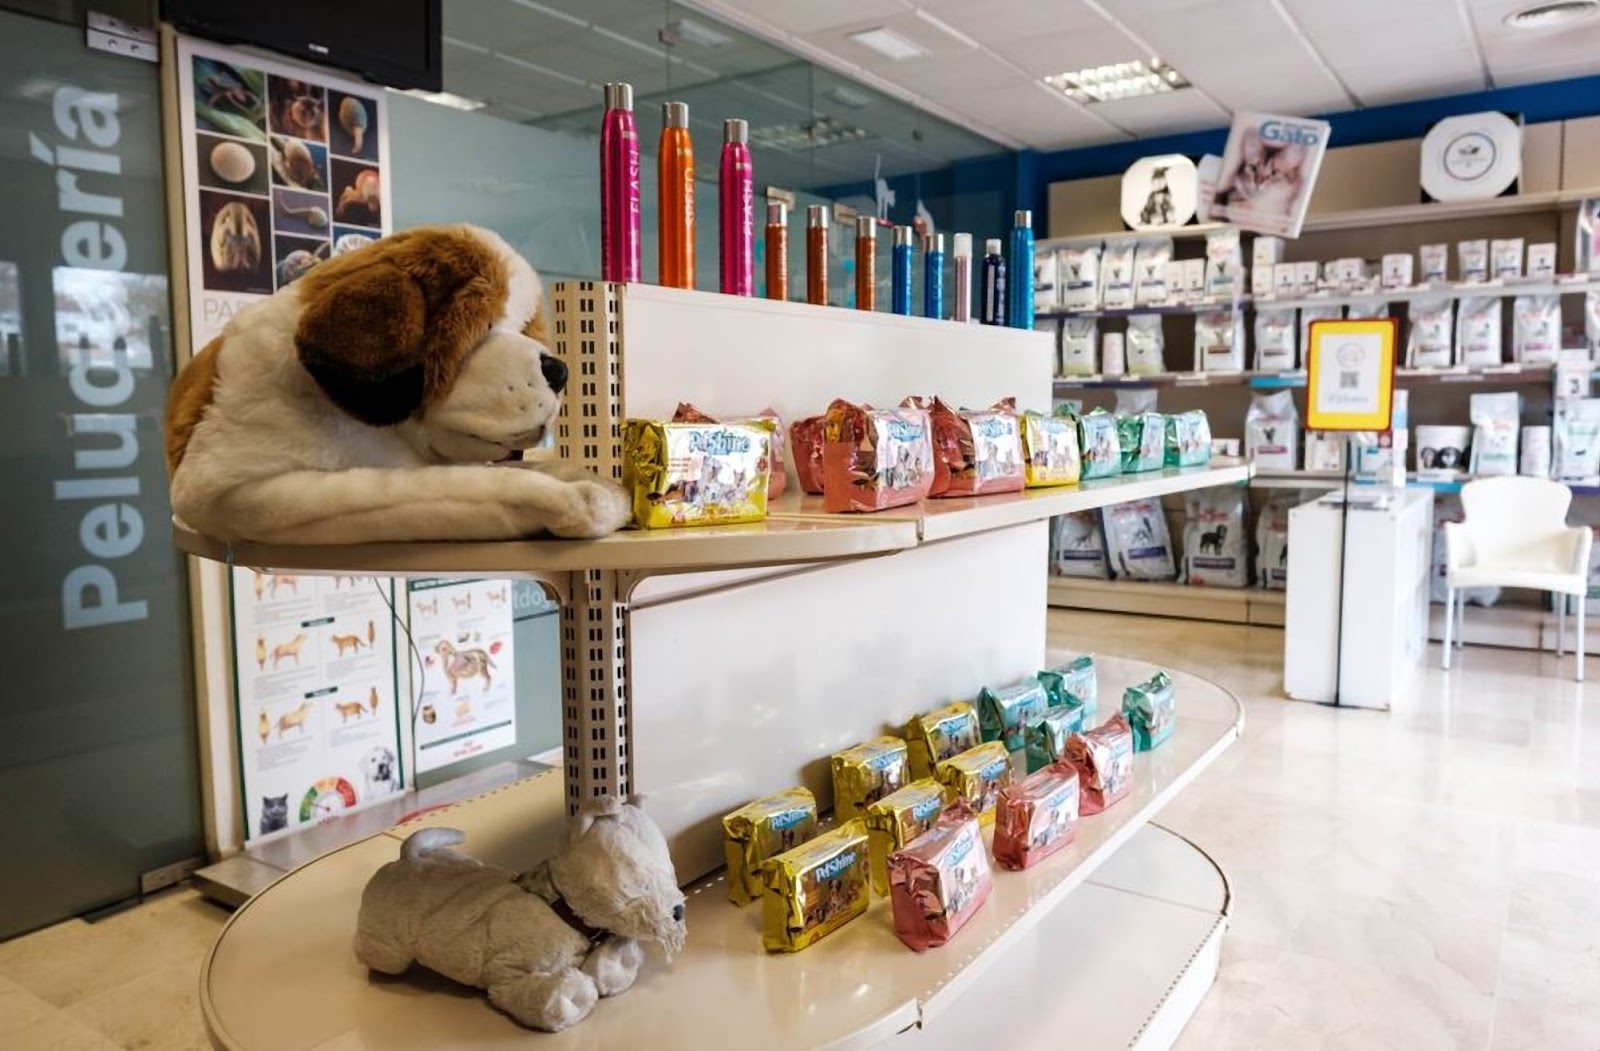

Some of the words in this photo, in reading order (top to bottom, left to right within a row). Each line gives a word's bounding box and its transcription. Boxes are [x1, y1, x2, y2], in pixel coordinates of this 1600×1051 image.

[1259, 121, 1318, 145] Gato
[629, 148, 640, 214] FLASH
[29, 86, 149, 631] Peluqería
[688, 428, 752, 456] PetShine
[770, 808, 809, 832] PetShine
[814, 850, 858, 883] PetShine
